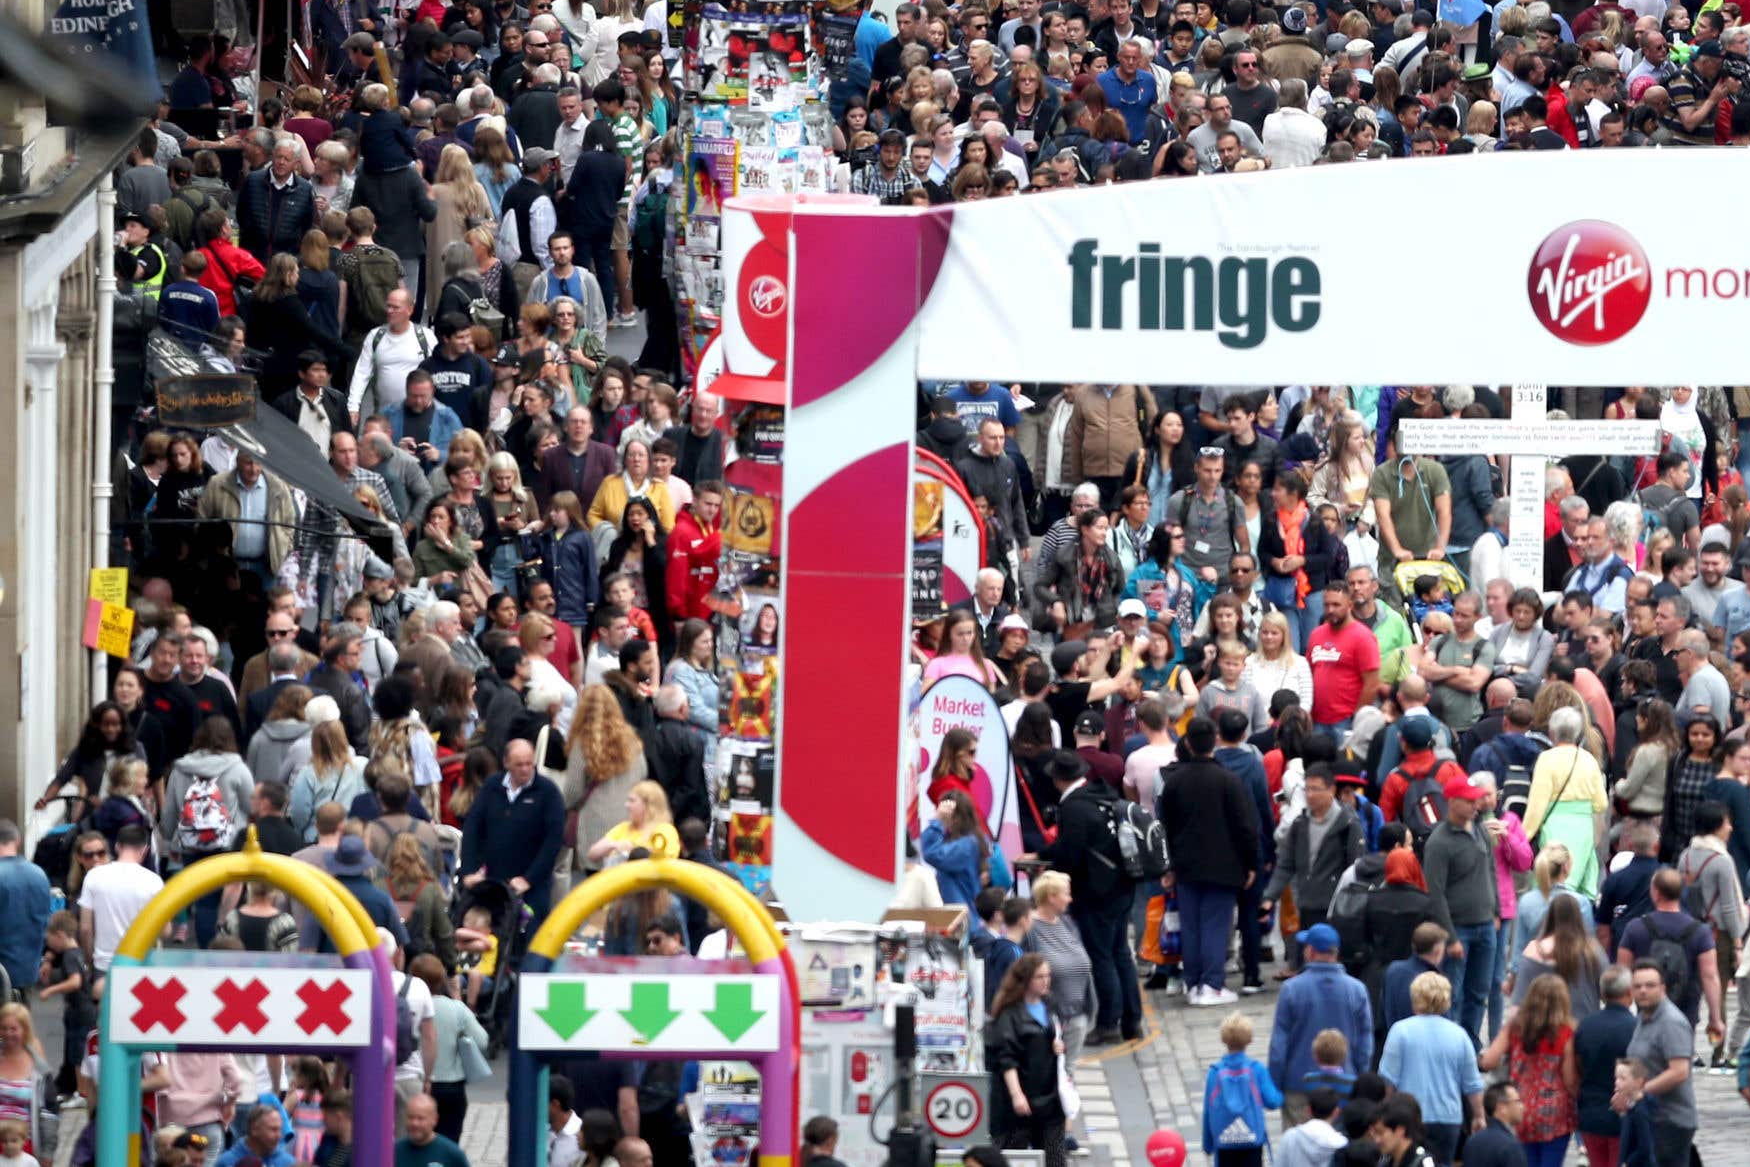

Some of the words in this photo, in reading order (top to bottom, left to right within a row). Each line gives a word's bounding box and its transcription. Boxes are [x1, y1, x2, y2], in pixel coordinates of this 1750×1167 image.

[1069, 238, 1321, 349] fringe
[1537, 233, 1643, 331] Virgin
[752, 280, 785, 312] Virgin
[432, 371, 471, 386] OSTON
[1516, 393, 1543, 402] 3:16
[934, 695, 987, 716] Market
